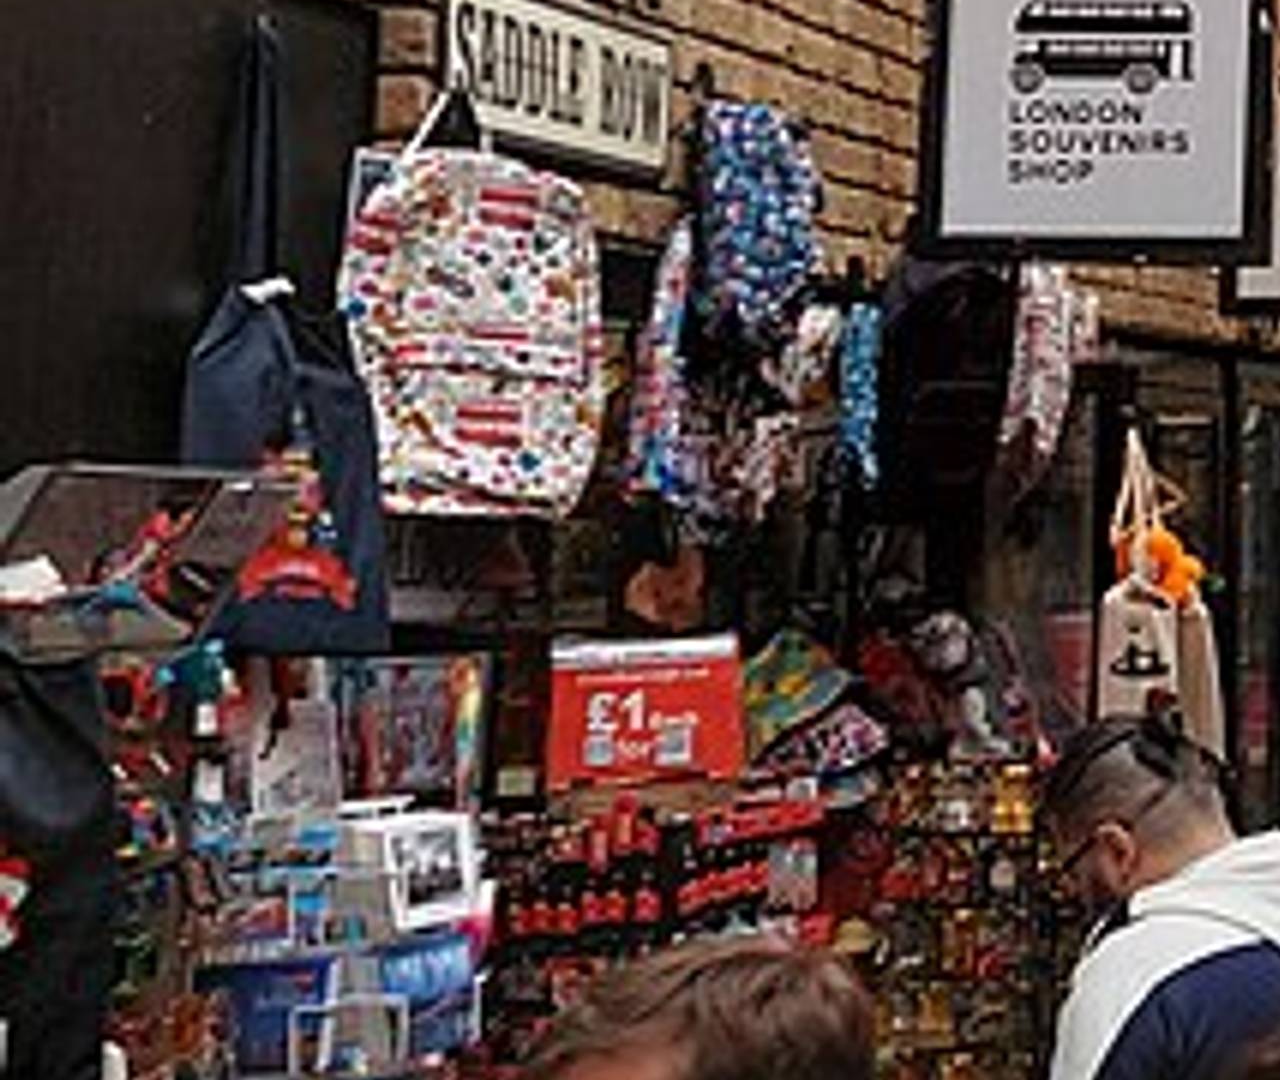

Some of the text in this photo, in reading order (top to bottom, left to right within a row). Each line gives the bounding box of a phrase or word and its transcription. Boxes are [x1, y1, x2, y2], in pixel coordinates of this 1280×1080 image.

[599, 43, 669, 148] ROW
[1009, 100, 1144, 124] LONDON
[1009, 130, 1190, 156] SOUVENIRS
[1009, 159, 1094, 185] SHOP
[587, 689, 645, 731] £1
